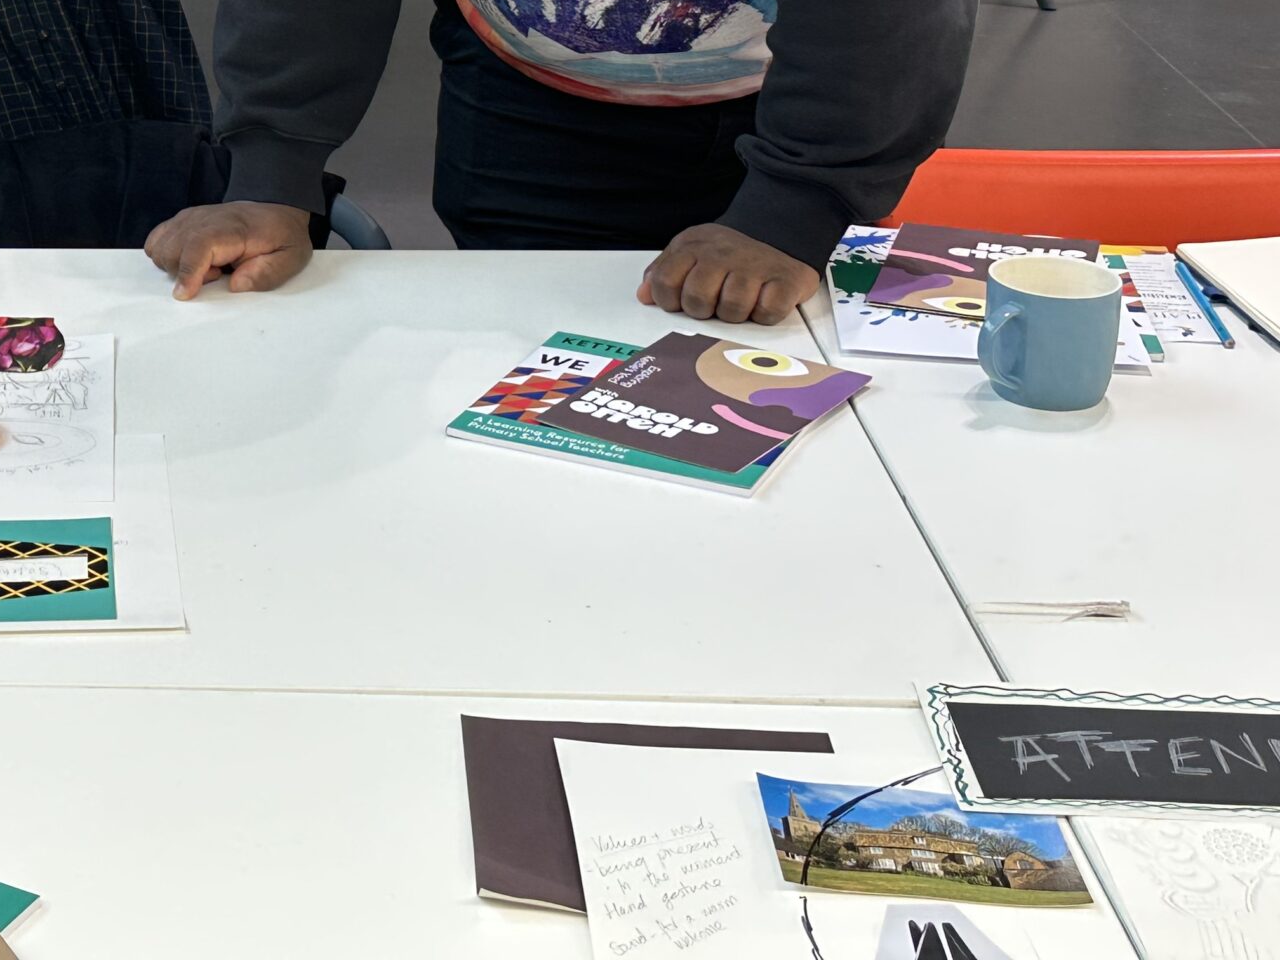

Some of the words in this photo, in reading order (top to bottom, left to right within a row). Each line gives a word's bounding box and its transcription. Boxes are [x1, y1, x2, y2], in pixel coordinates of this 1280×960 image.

[540, 354, 590, 371] WE
[580, 390, 719, 434] HAROLD
[468, 421, 514, 438] Primary
[520, 431, 565, 447] School
[568, 442, 626, 459] Teachers
[473, 415, 483, 423] A
[487, 418, 542, 437] Learning
[546, 430, 608, 449] Resource
[609, 444, 630, 453] for
[997, 730, 1280, 782] ATTEN
